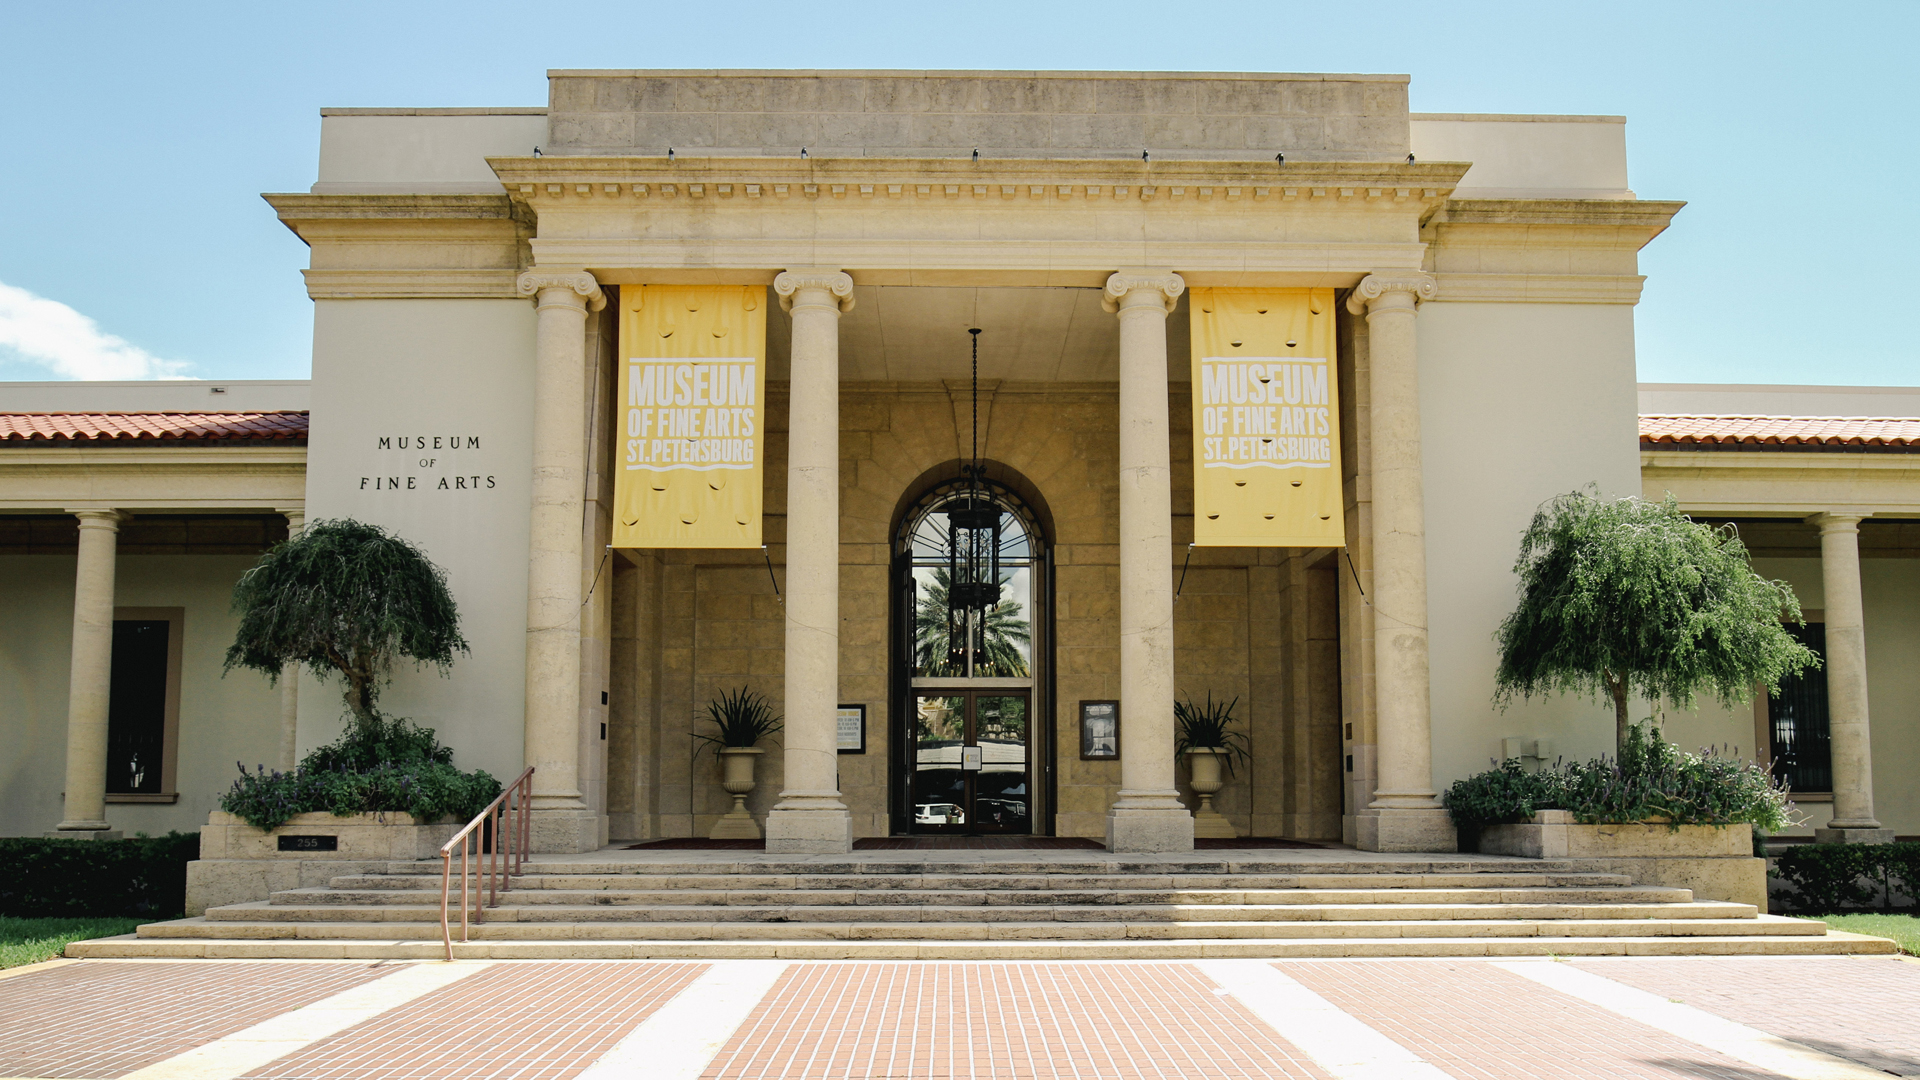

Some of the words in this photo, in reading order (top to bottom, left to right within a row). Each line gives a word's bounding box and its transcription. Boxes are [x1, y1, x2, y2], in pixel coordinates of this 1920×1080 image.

[628, 364, 756, 406] MUSEUM
[1201, 363, 1329, 405] MUSEUM
[627, 408, 653, 438] OF
[657, 408, 701, 437] FINE
[703, 408, 755, 437] ARTS
[1202, 406, 1228, 435] OF
[1232, 406, 1277, 435] FINE
[1280, 406, 1330, 436] ARTS
[378, 436, 480, 450] MUSEUM
[419, 458, 437, 468] OF
[359, 476, 417, 490] FINE
[437, 475, 496, 490] ARTS
[297, 838, 318, 848] 255
